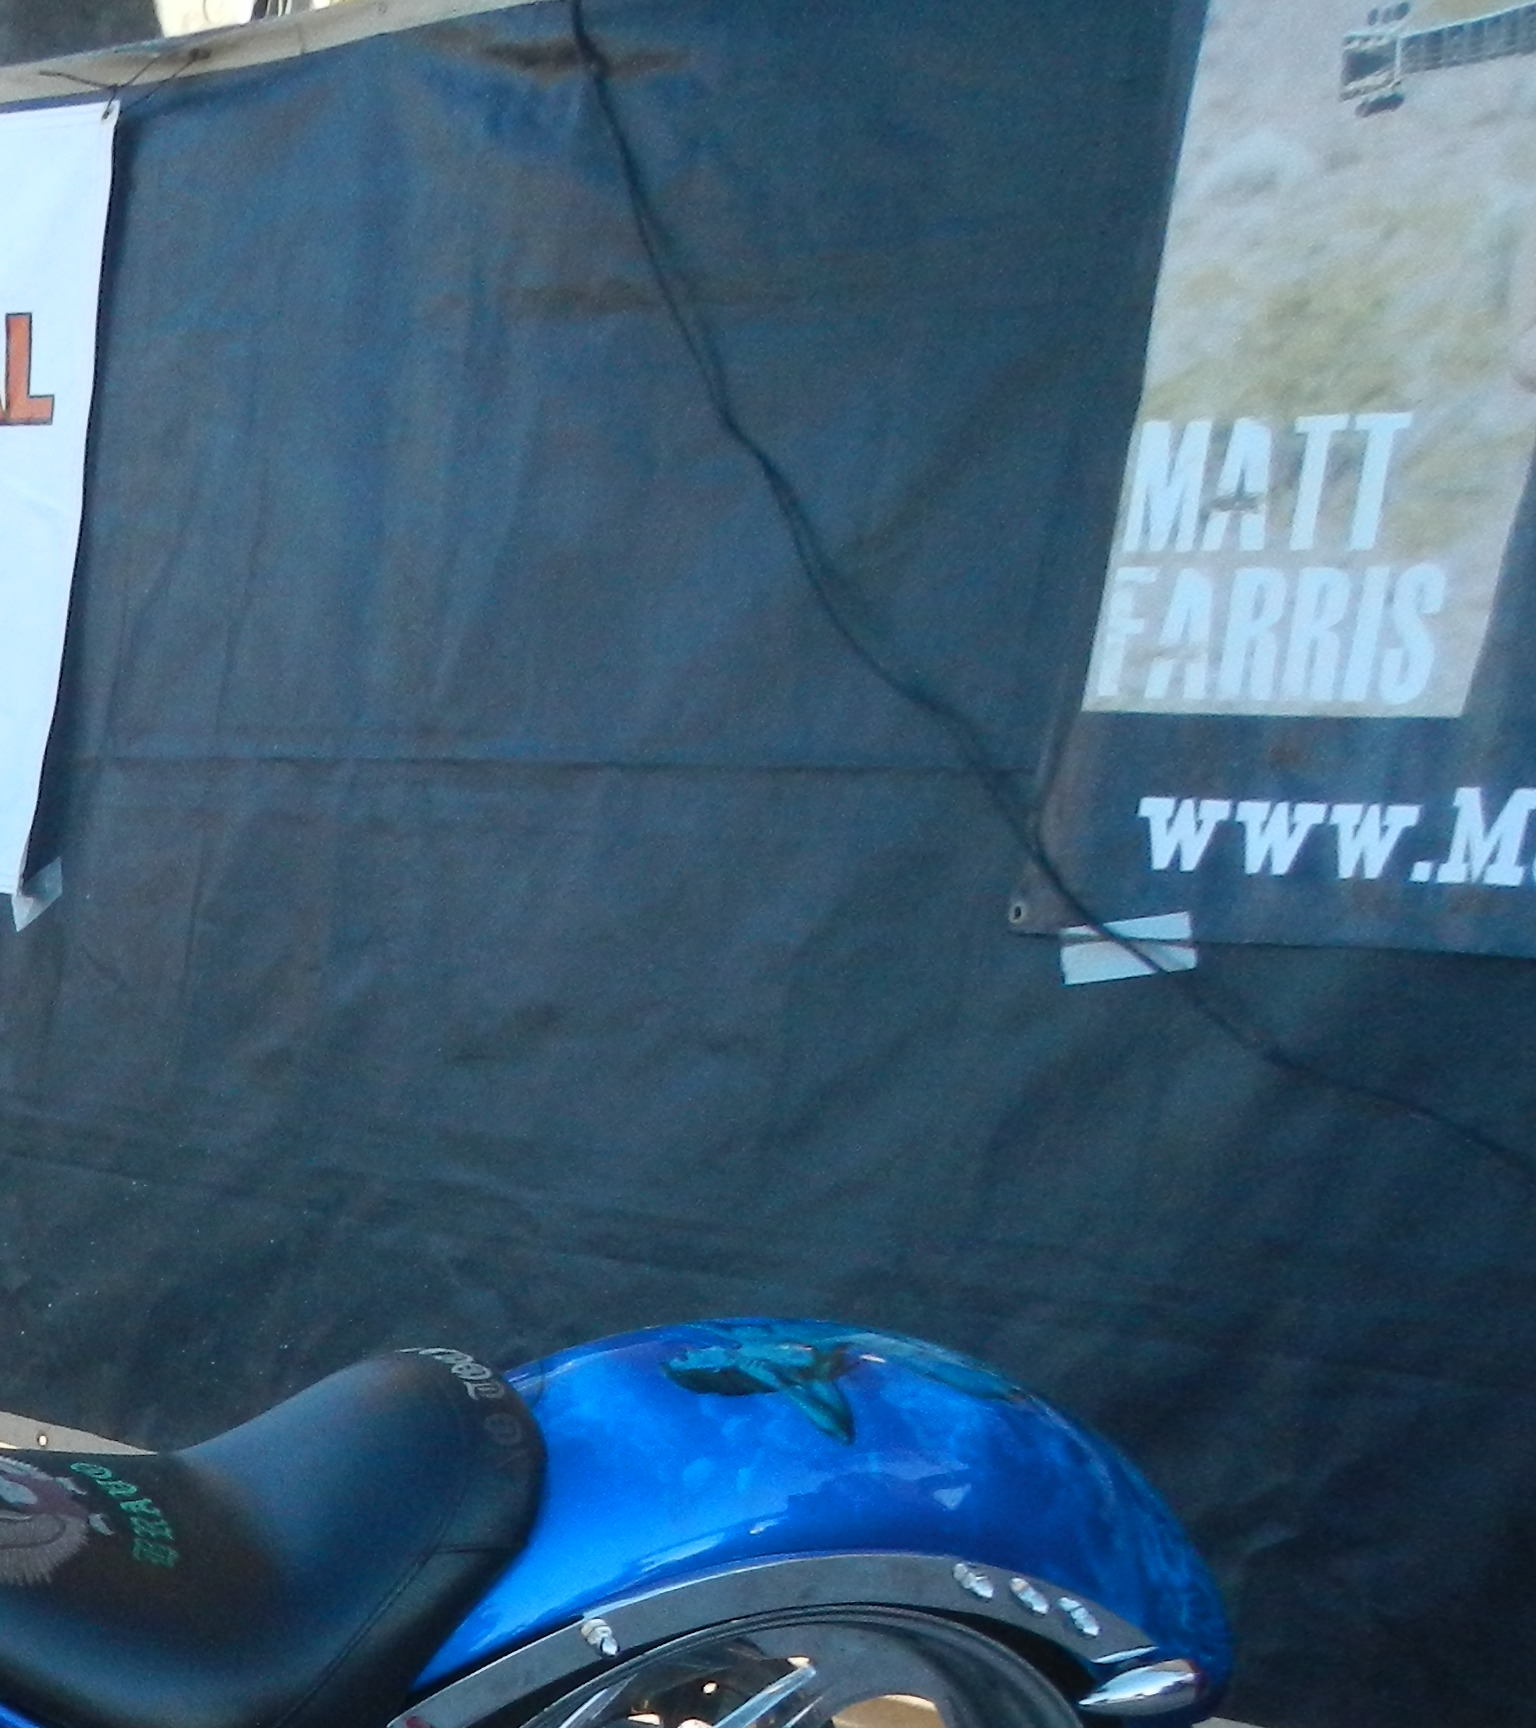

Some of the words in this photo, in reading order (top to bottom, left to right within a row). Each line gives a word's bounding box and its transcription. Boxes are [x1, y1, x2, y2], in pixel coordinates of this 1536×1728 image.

[1122, 411, 1413, 552] MATT
[1093, 561, 1448, 705] FARRIS
[1137, 786, 1536, 891] www.M
